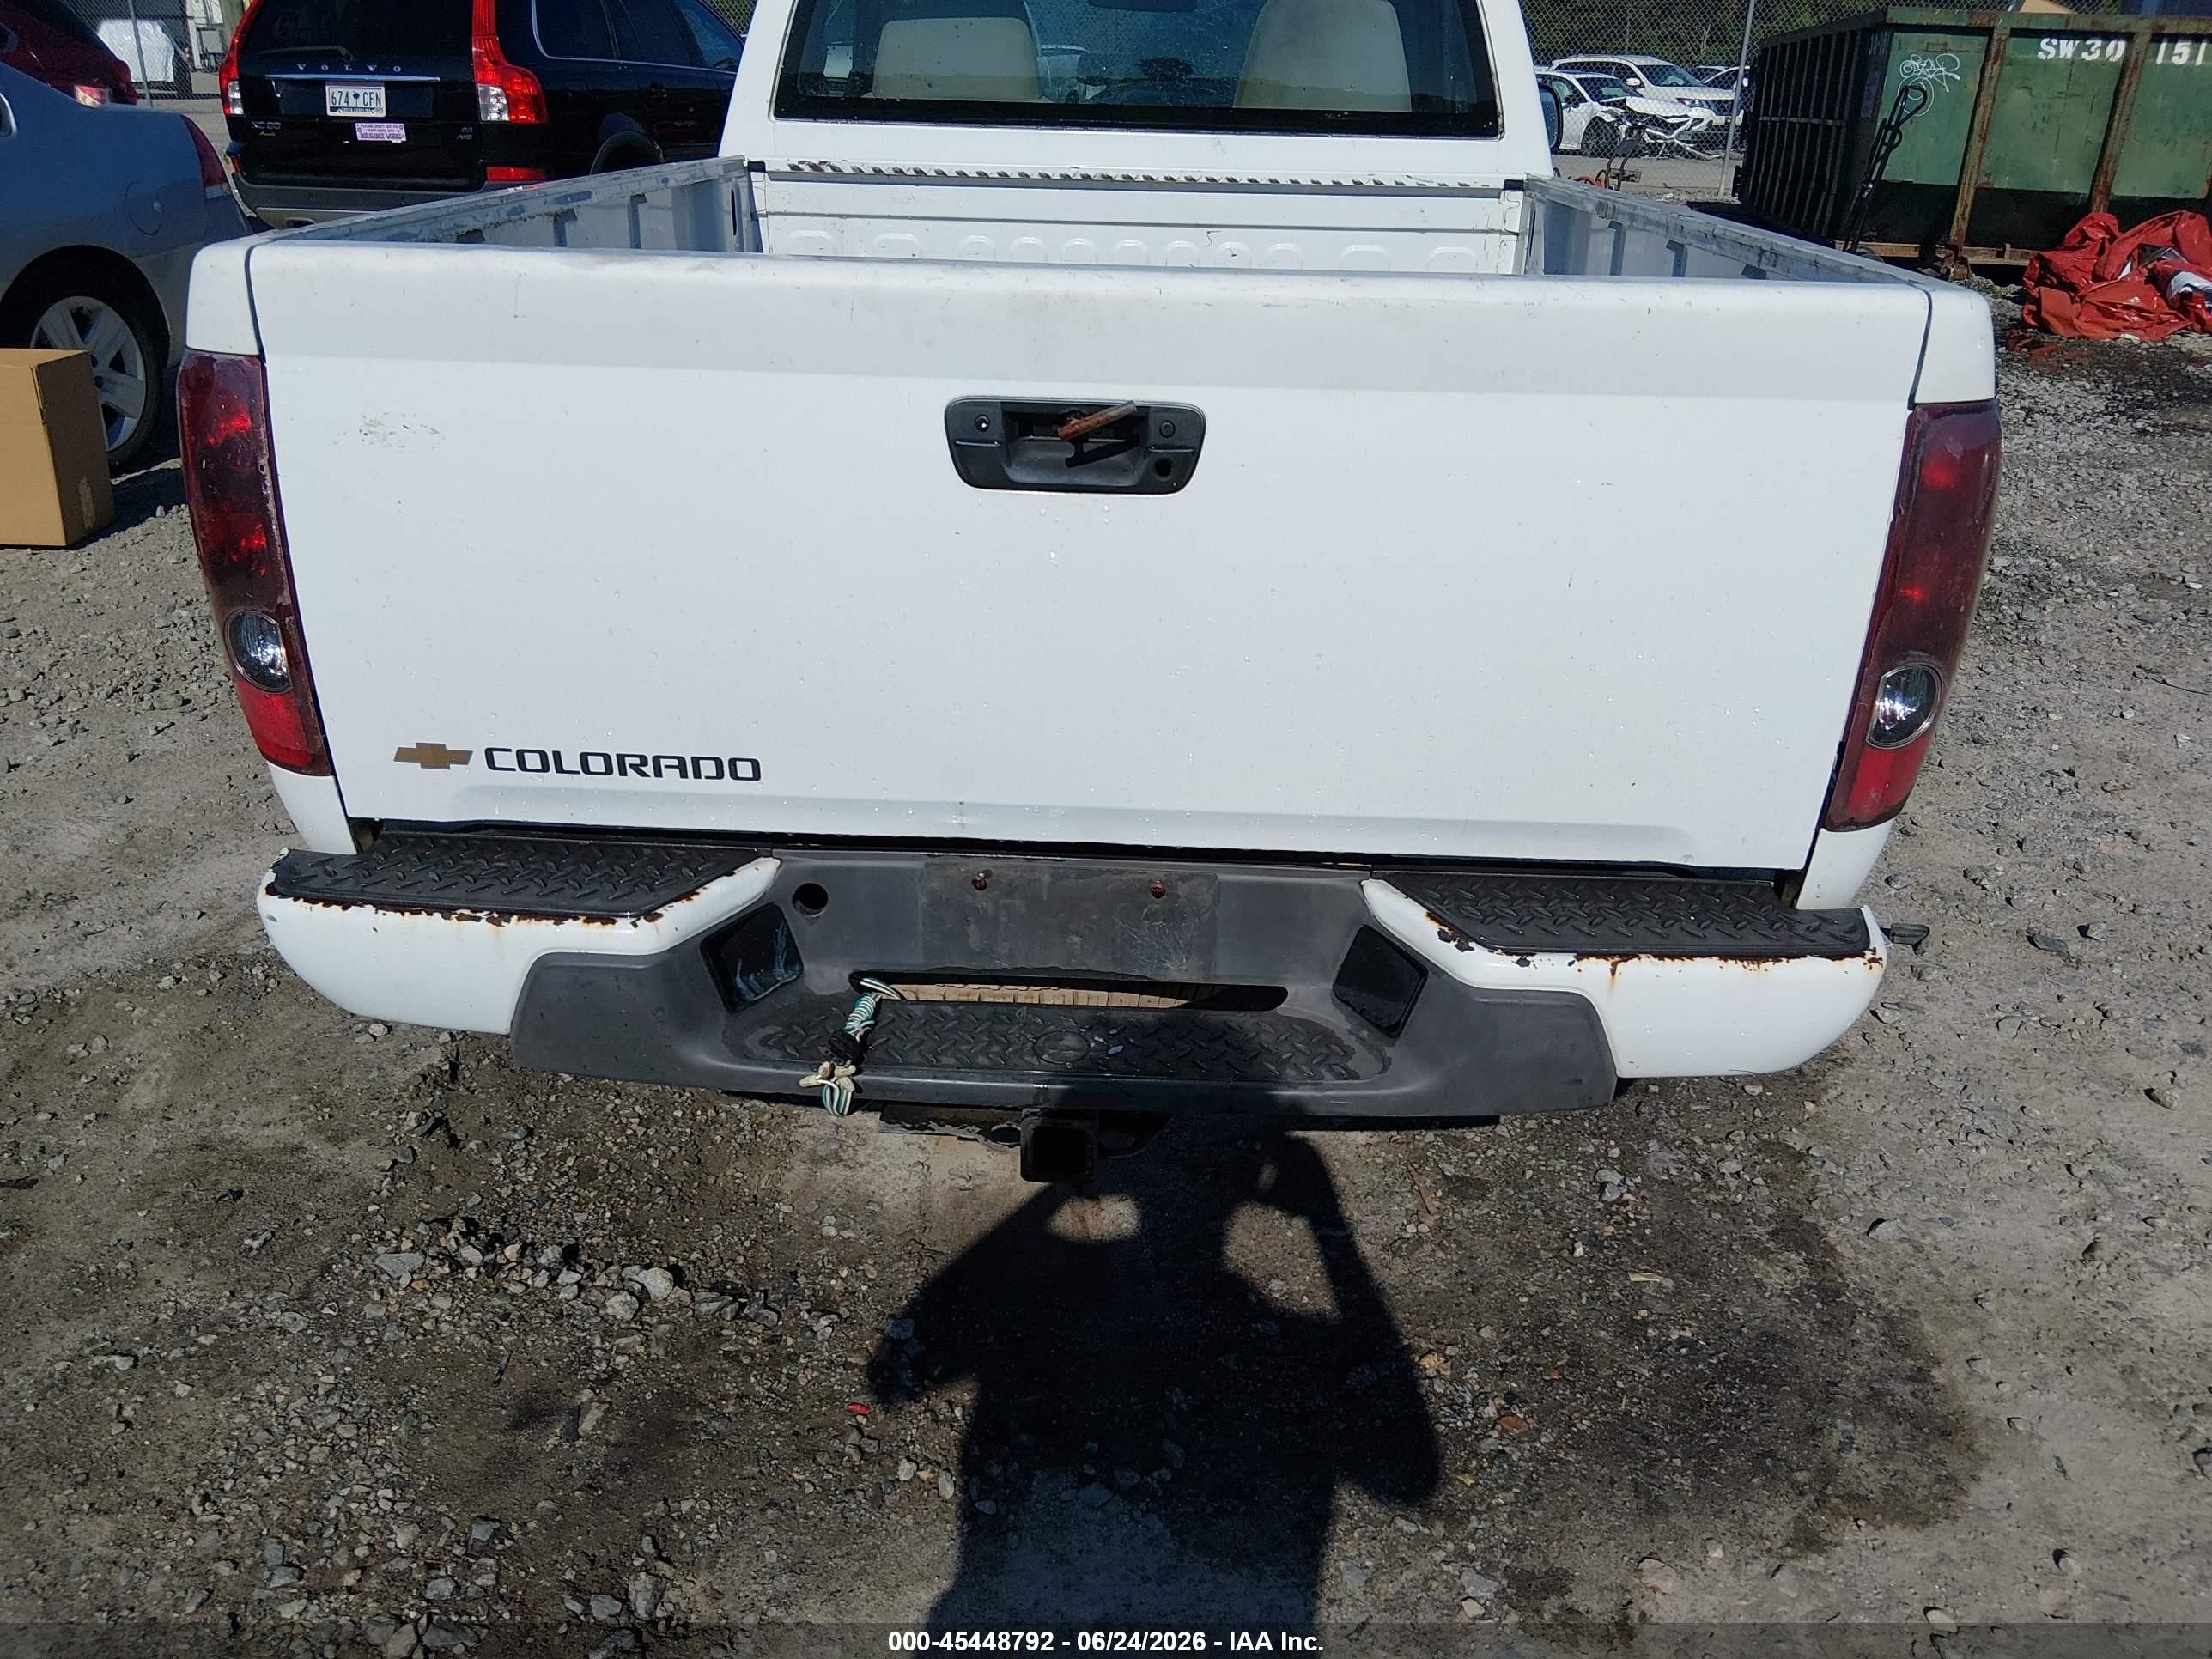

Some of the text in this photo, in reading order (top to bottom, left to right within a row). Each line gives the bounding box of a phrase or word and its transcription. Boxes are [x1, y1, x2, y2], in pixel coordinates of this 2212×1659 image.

[296, 64, 402, 73] VOLVO
[331, 90, 381, 106] 674 CFN
[484, 747, 762, 781] COLORADO
